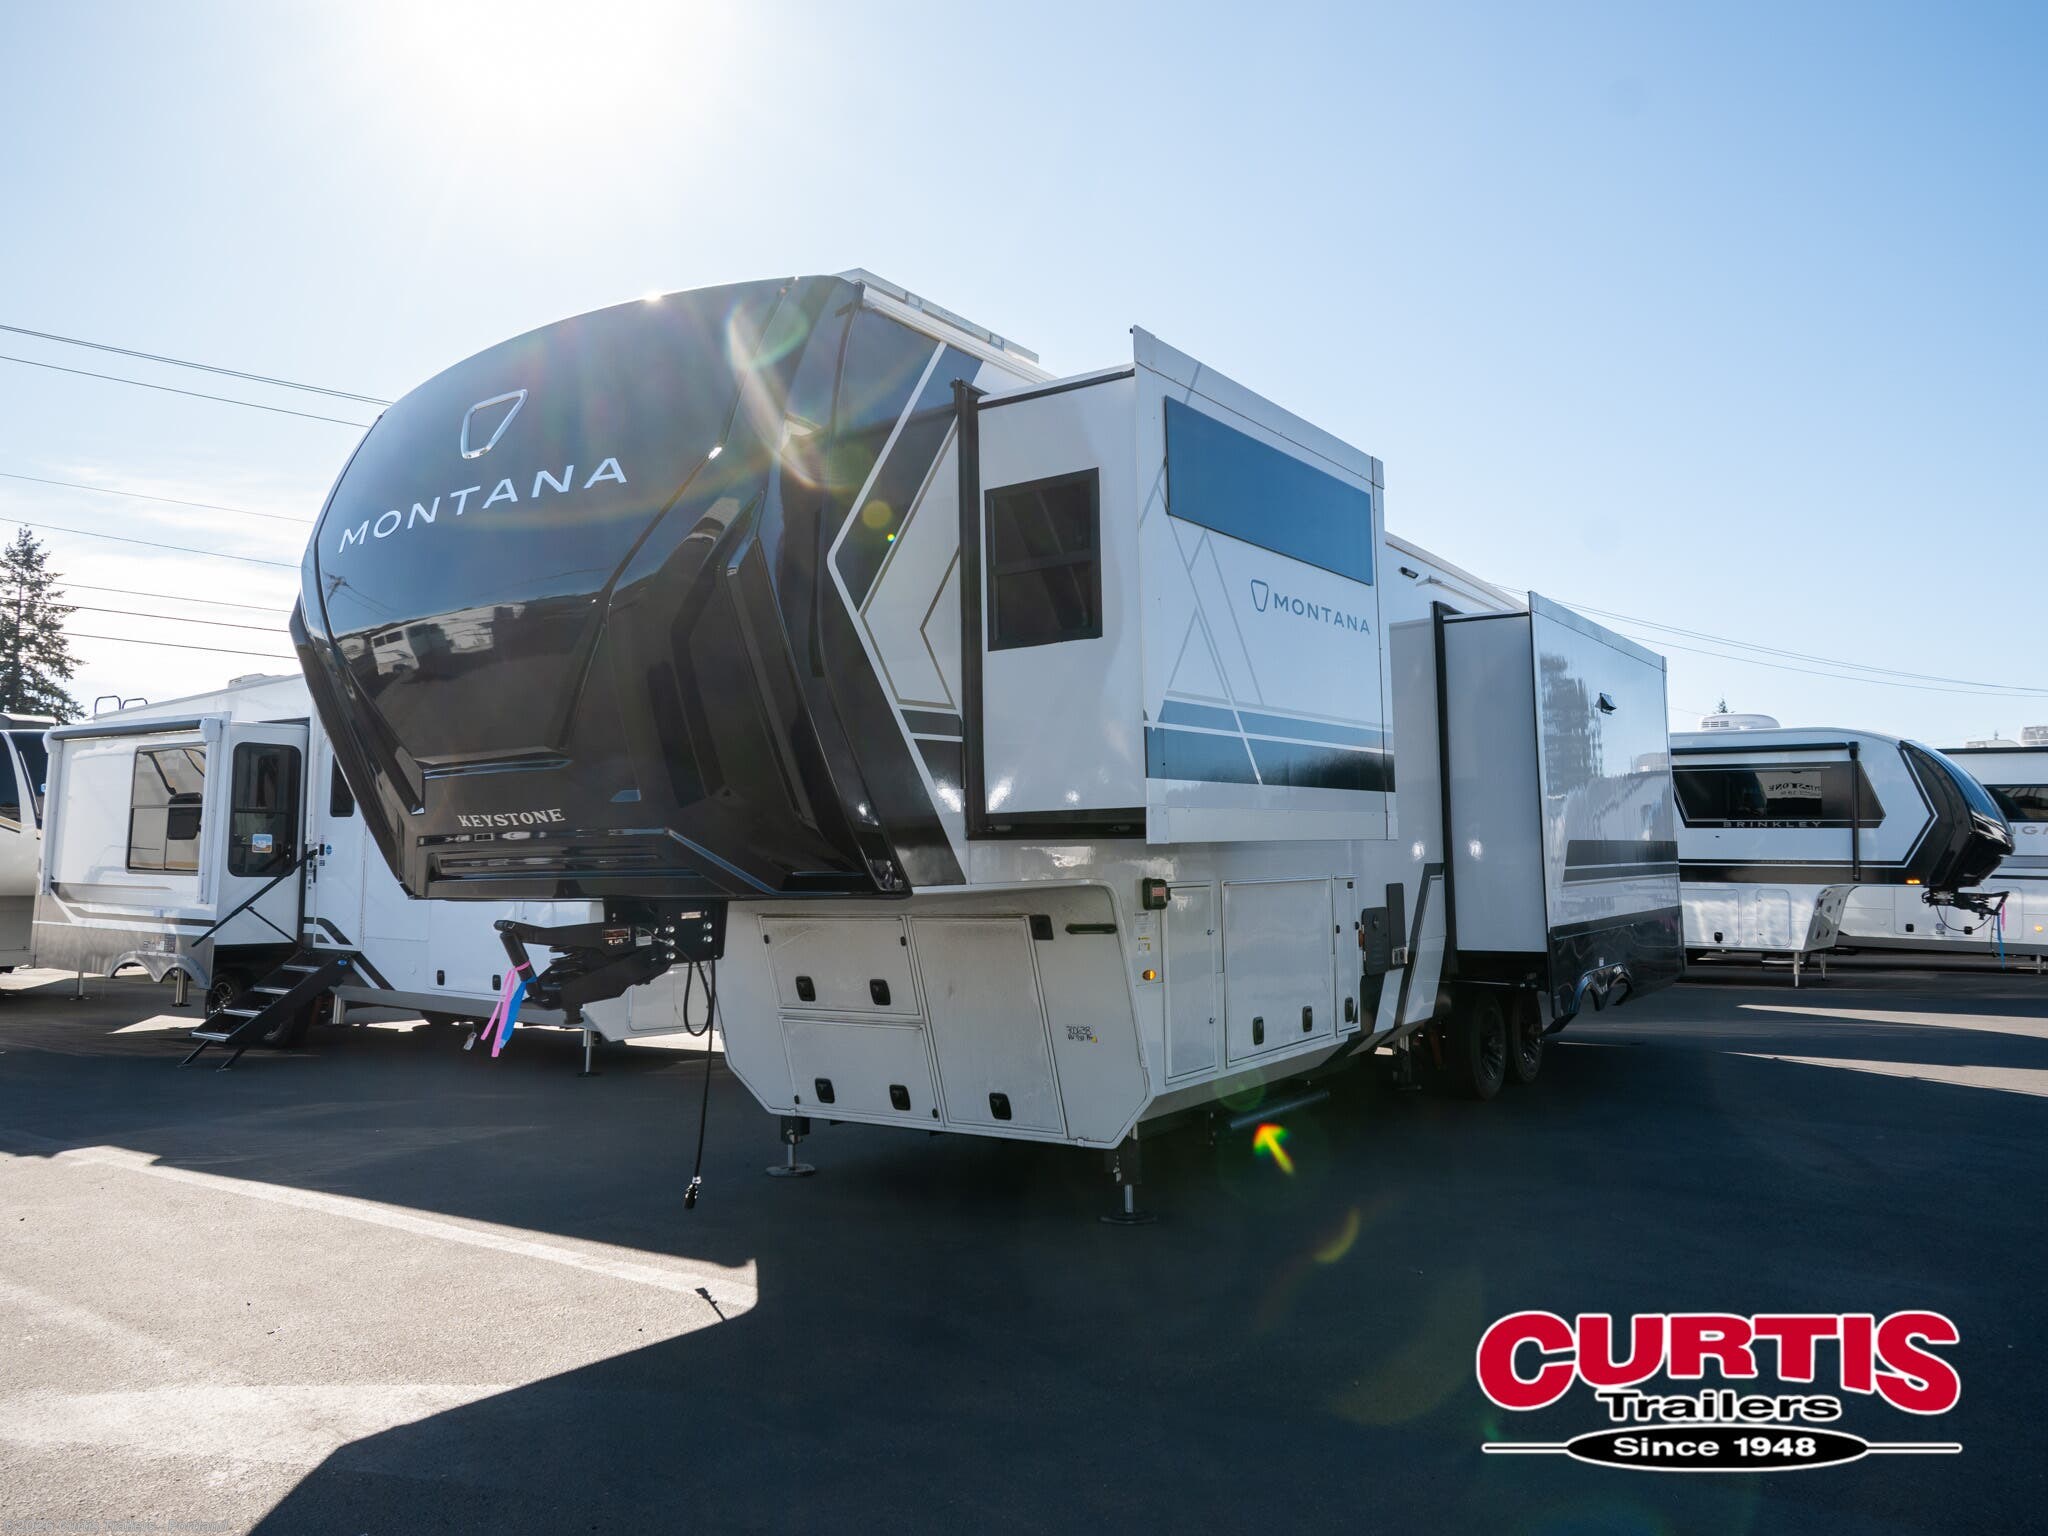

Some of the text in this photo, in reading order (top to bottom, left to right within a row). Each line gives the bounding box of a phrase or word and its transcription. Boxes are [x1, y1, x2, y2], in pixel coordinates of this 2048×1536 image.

[338, 457, 627, 553] MONTANA
[1273, 592, 1371, 635] MONTANA
[458, 808, 565, 828] KEYSTONE
